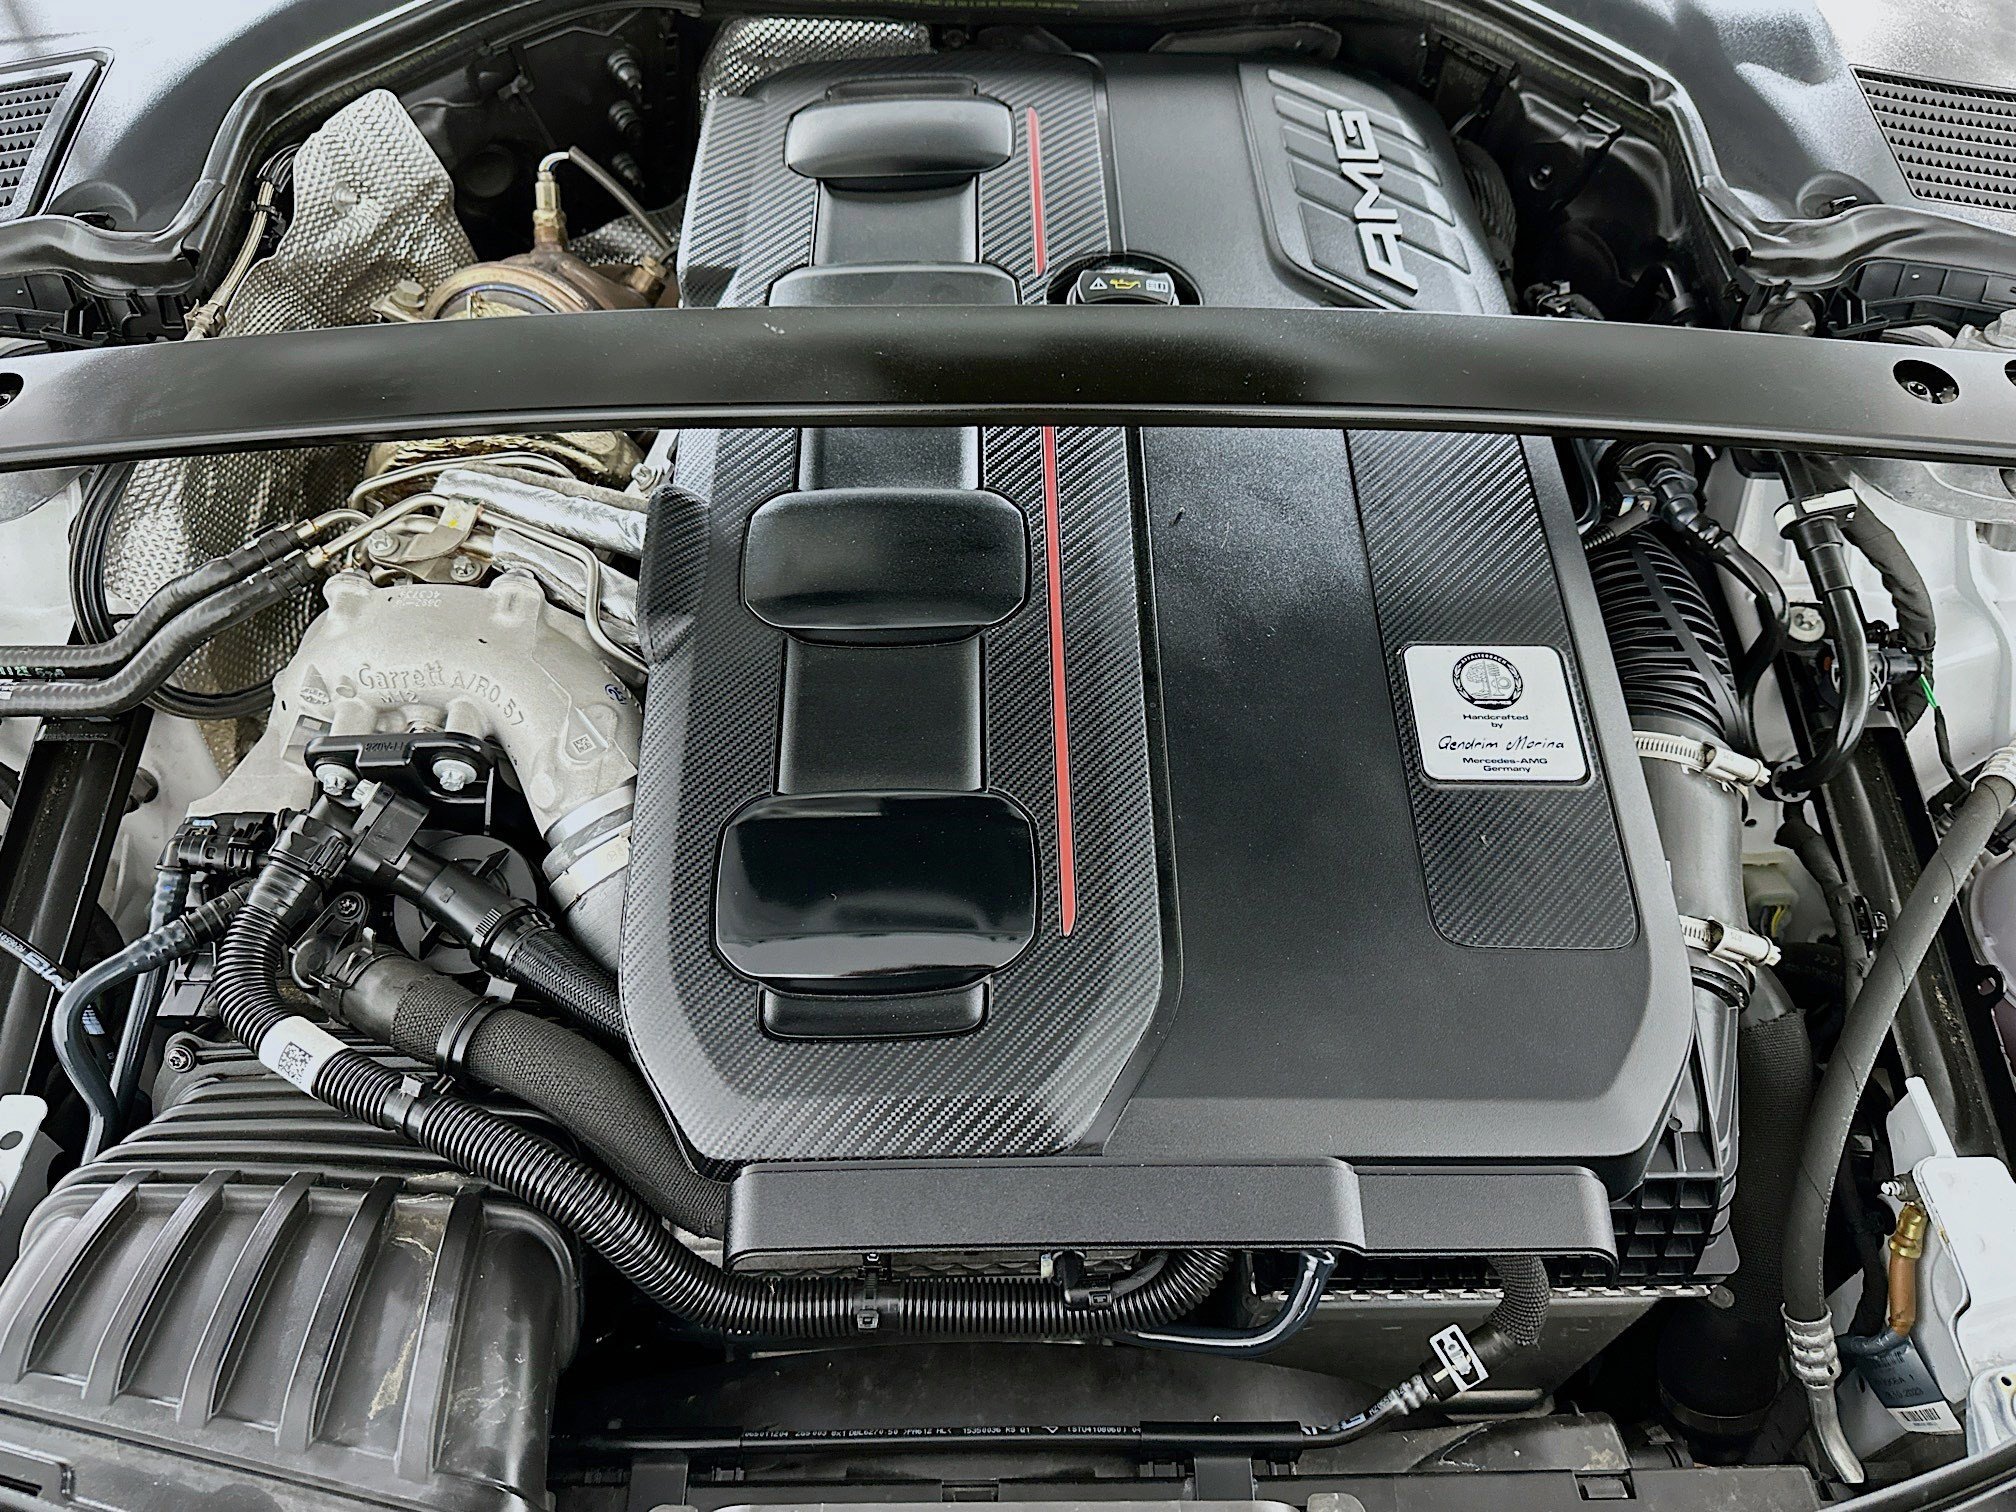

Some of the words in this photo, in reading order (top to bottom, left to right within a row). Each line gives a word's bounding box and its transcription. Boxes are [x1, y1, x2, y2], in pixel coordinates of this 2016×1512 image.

[1325, 108, 1419, 296] AMG
[358, 660, 445, 690] Garrett
[1462, 713, 1529, 721] Handcrafted
[1491, 721, 1503, 729] by
[1438, 735, 1499, 751] Gendrim
[1505, 735, 1565, 751] Morina
[1462, 757, 1548, 765] Mercedes-AMG
[1483, 765, 1531, 773] Germany
